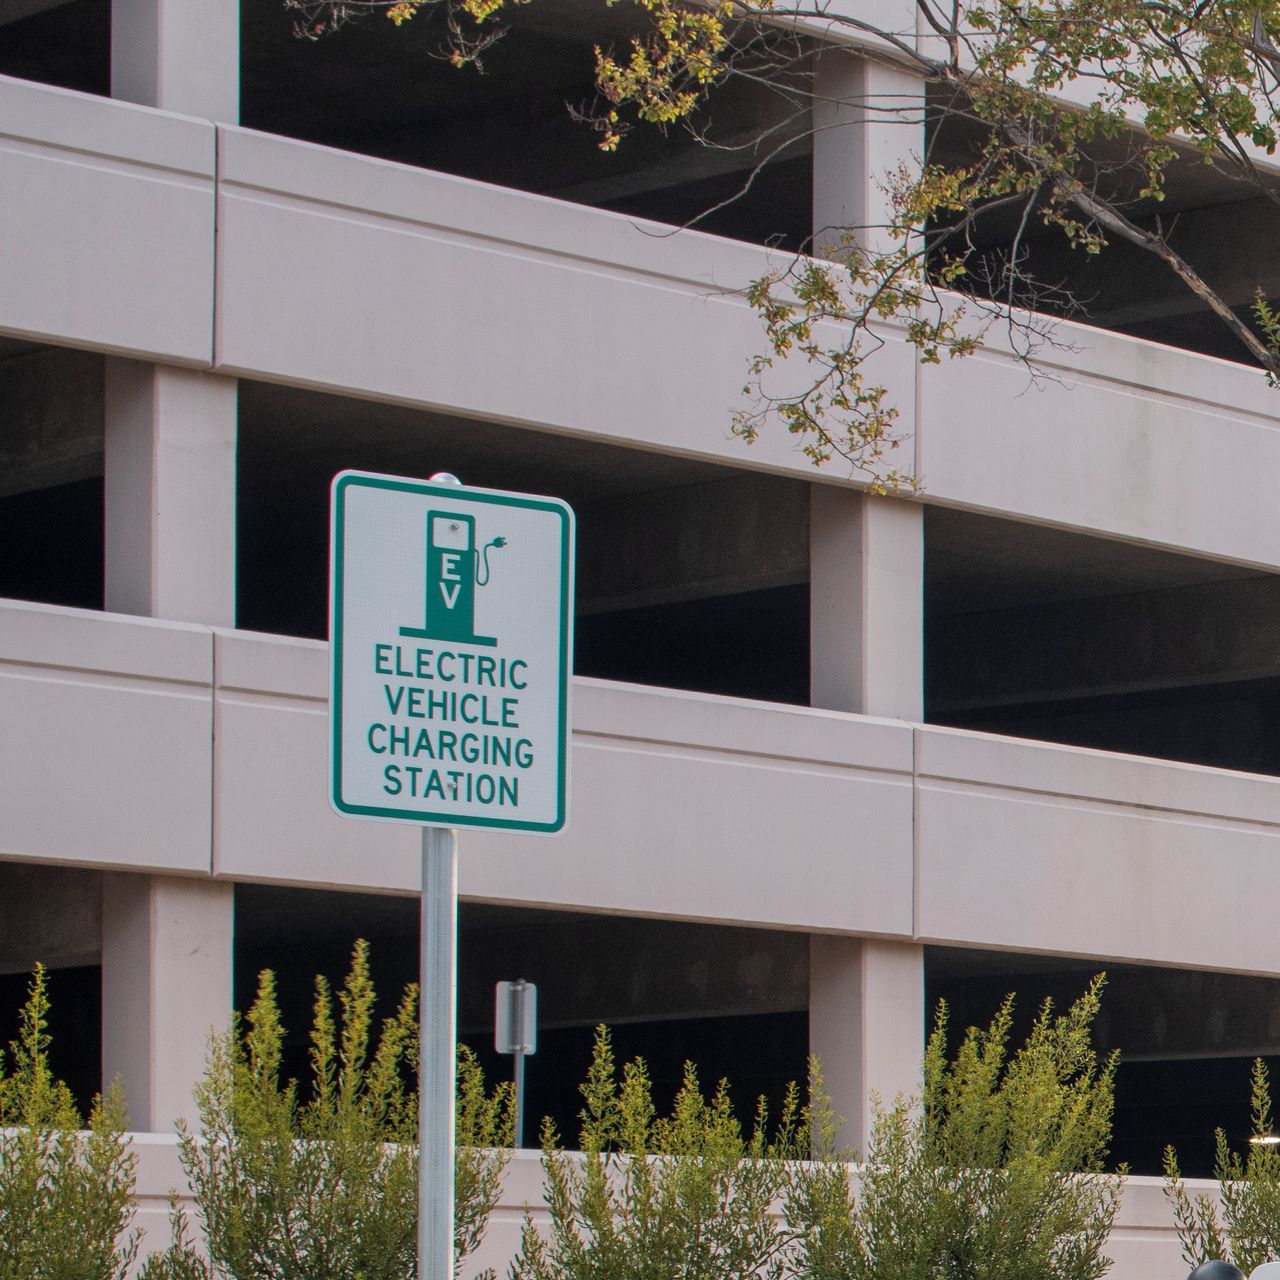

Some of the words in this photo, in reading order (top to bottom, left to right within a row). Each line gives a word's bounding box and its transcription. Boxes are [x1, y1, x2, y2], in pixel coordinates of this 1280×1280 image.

[439, 552, 461, 609] EV
[374, 643, 528, 690] ELECTRIC
[384, 684, 520, 729] VEHICLE
[368, 723, 534, 769] CHARGING
[383, 765, 519, 807] STATION
